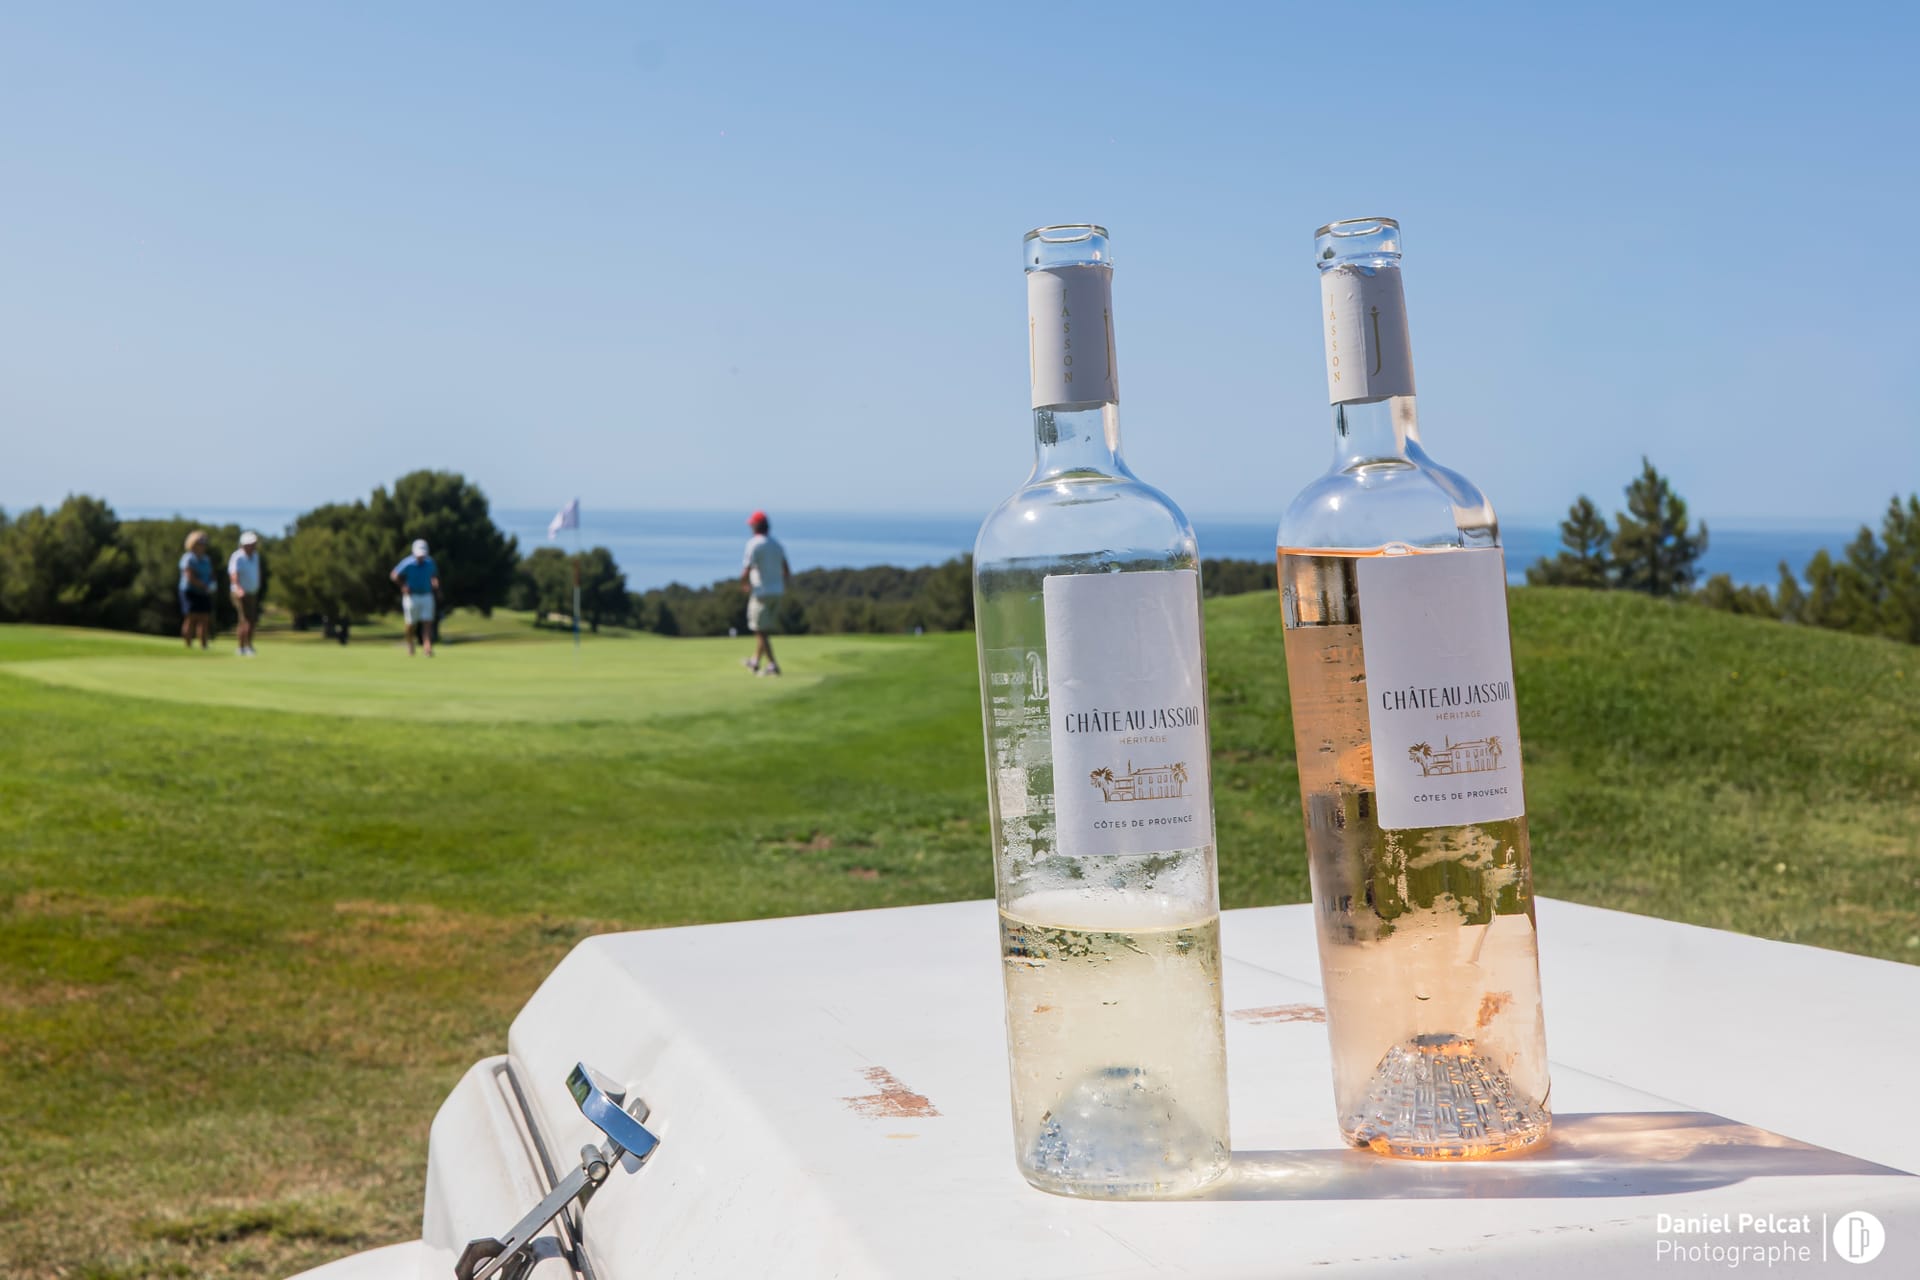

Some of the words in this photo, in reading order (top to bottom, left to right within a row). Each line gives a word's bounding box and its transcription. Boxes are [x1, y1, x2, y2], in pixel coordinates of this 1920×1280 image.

[1060, 288, 1073, 384] JASSON
[1329, 293, 1342, 383] JASSON
[1383, 686, 1460, 711] CHÂTEAU
[1464, 680, 1511, 705] JASSON
[1065, 708, 1146, 733] CHÂTEAU
[1149, 706, 1199, 730] JASSON
[1413, 793, 1447, 803] CÔTES
[1451, 792, 1463, 800] DE
[1467, 786, 1508, 799] PROVENCE
[1093, 820, 1127, 829] CÔTES
[1131, 820, 1144, 828] DE
[1148, 814, 1193, 826] PROVENCE
